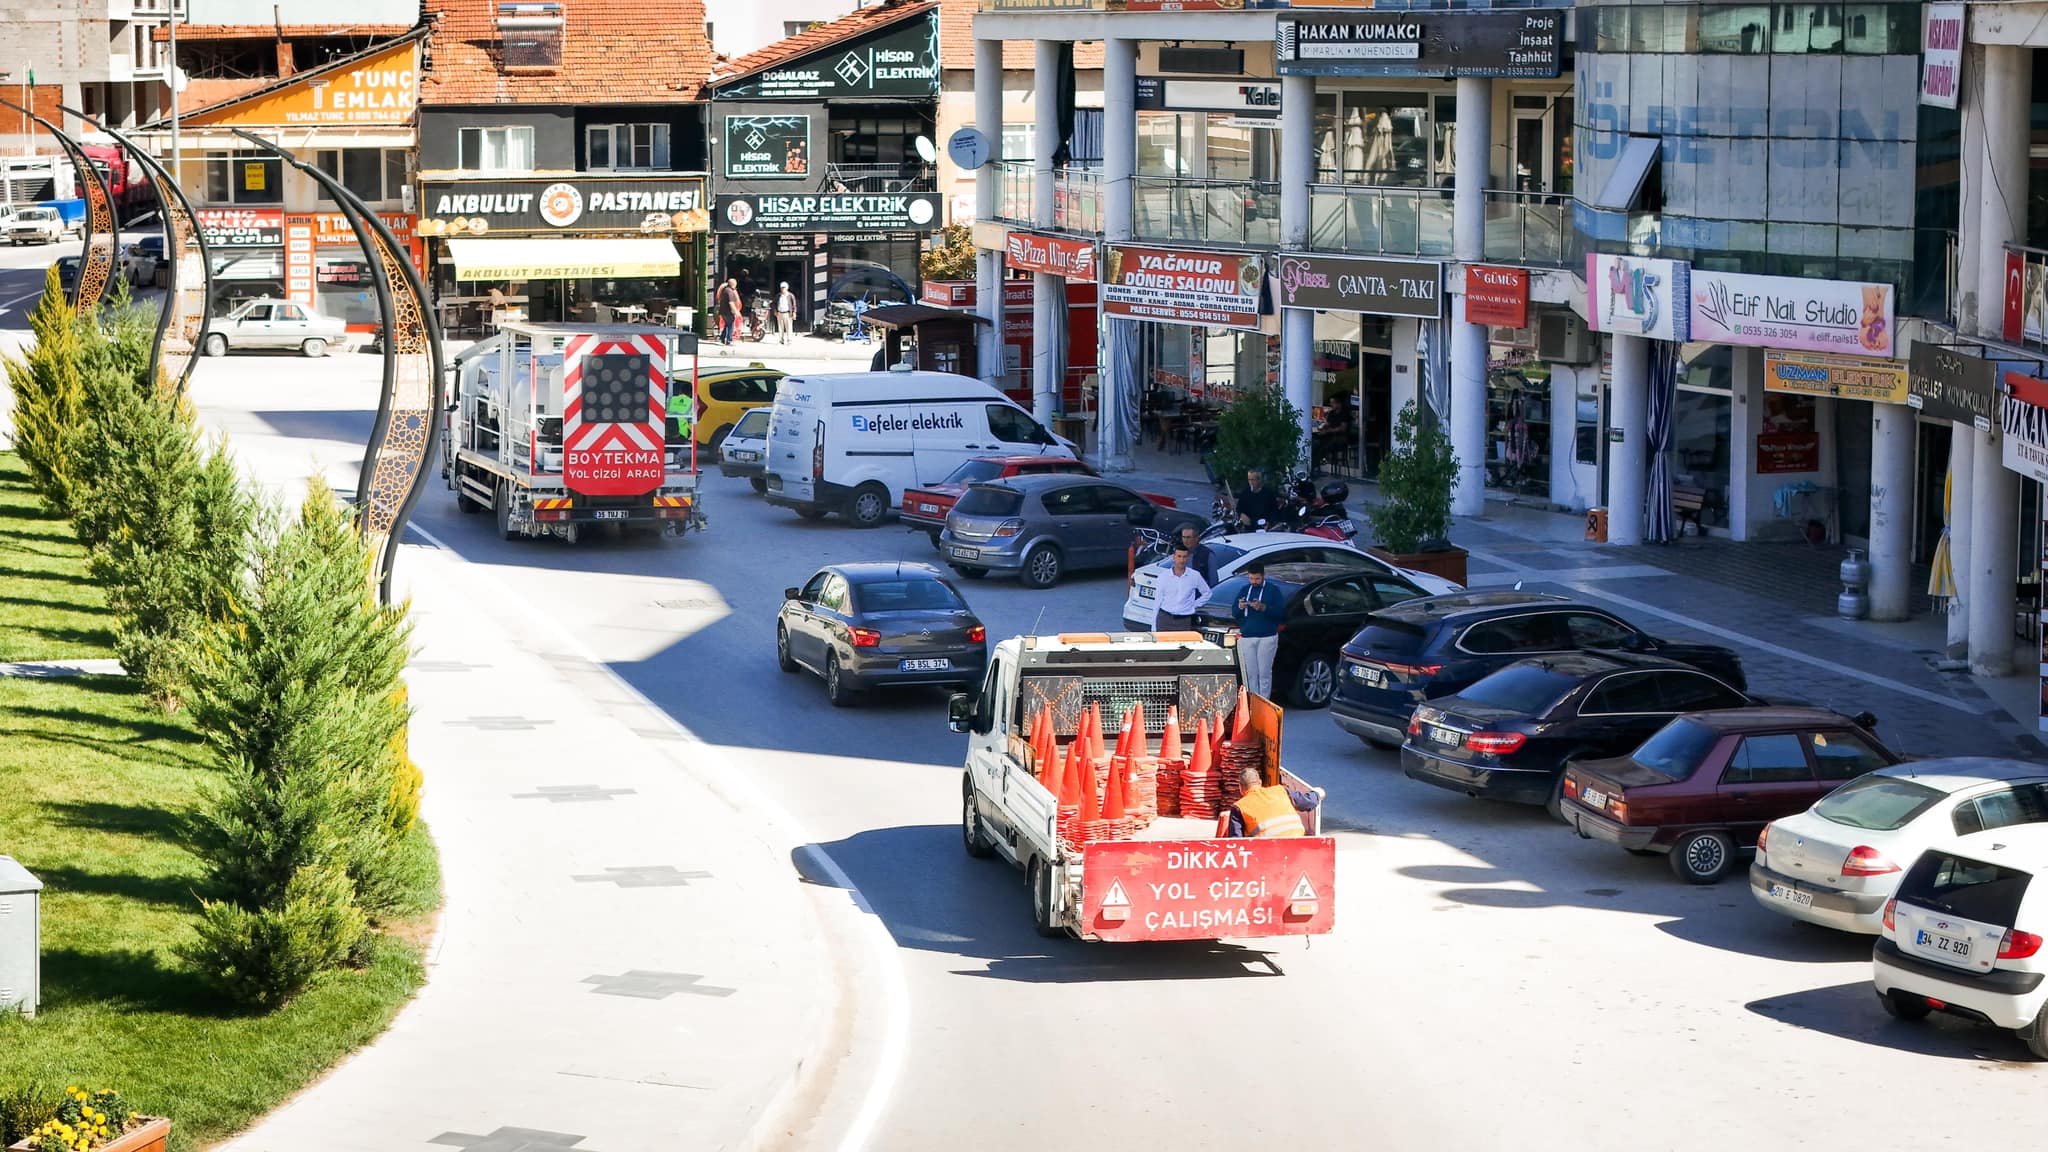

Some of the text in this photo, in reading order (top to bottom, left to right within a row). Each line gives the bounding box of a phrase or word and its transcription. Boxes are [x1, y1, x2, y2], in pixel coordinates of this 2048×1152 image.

[1300, 24, 1349, 39] HAKAN
[1526, 17, 1553, 30] Proje
[1520, 32, 1553, 46] İnşaat
[876, 51, 914, 62] HİSAR
[1509, 51, 1553, 63] Taahhüt
[352, 71, 412, 88] TUNÇ
[876, 66, 935, 79] ELEKTRİK
[333, 91, 412, 108] EMLAK
[1245, 86, 1280, 106] Kale
[740, 151, 772, 161] HİSAR
[732, 163, 780, 173] ELEKTRİK
[436, 190, 700, 214] AKBULUT PASTANESİ
[1023, 239, 1046, 265] Pizza
[1138, 253, 1223, 275] YAĞMUR
[463, 266, 615, 279] AKBULUT PASTANESİ
[1125, 268, 1236, 295] DÖNER SALONU
[1337, 274, 1387, 297] ÇANTA
[1400, 278, 1435, 300] TAKI
[1733, 293, 1858, 325] Elif Nail Studio
[1742, 325, 1762, 336] 0535
[1763, 327, 1778, 337] 326
[1779, 328, 1798, 339] 3054
[1776, 364, 1829, 383] UZMAN
[869, 414, 908, 434] efeler
[912, 411, 964, 429] elektrik
[568, 452, 660, 465] BOYTEKMA
[569, 467, 661, 480] YOL ÇİZGİ ARACI
[907, 660, 916, 668] 35
[933, 659, 947, 667] 374
[1149, 876, 1266, 901] YOL ÇİZGİ
[1775, 886, 1784, 897] 20
[1786, 890, 1791, 899] E
[1145, 907, 1273, 932] ÇALIŞMASI
[1923, 933, 1969, 955] 34 ZZ 920
